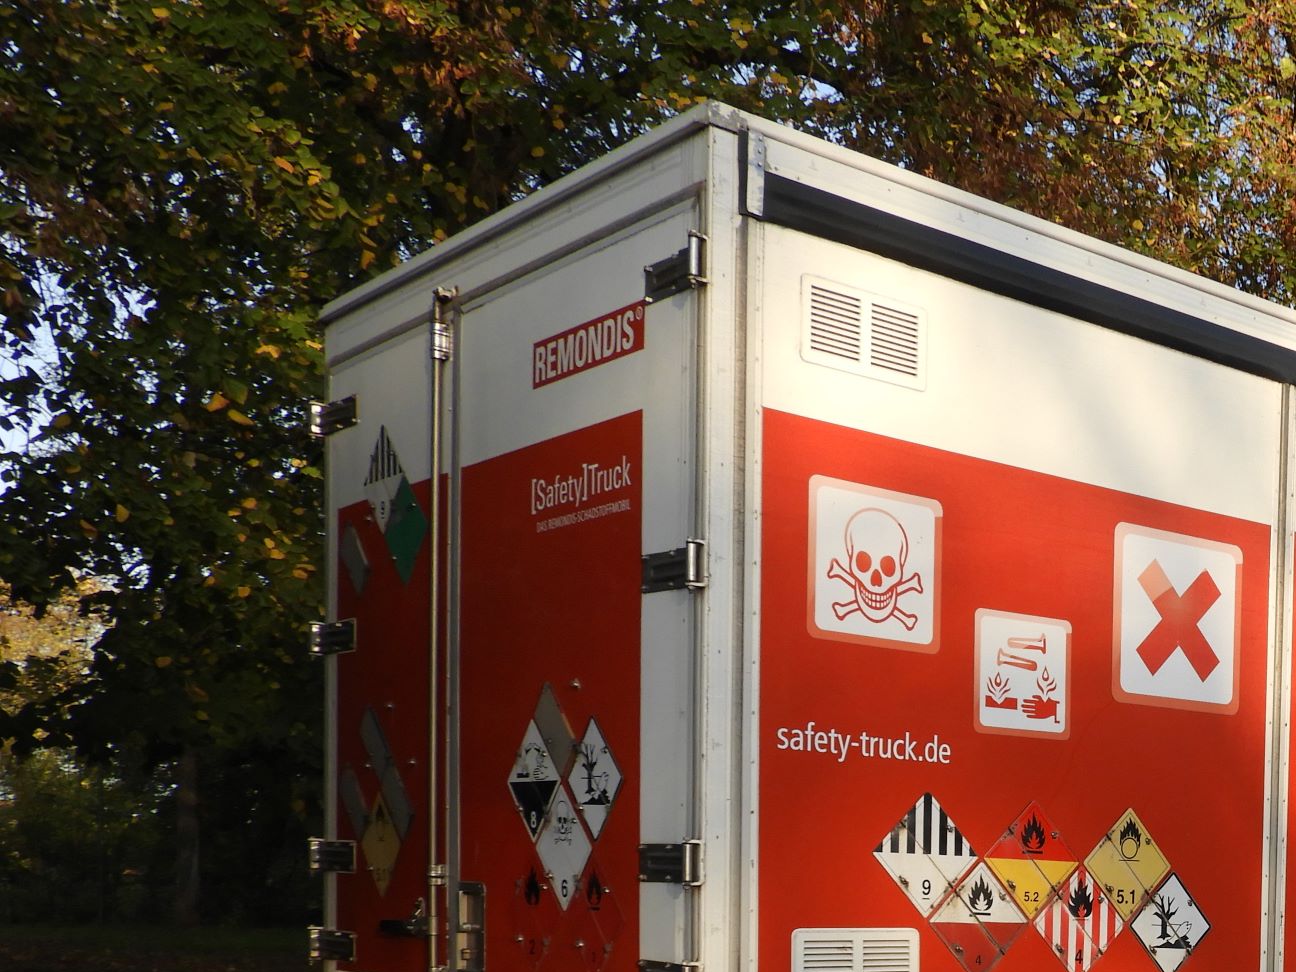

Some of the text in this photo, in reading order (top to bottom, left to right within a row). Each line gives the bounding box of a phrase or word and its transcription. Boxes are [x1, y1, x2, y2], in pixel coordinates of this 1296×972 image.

[776, 721, 951, 764] safety-truck.de
[530, 811, 537, 828] 8
[561, 879, 568, 898] 6
[922, 879, 931, 895] 9
[1023, 891, 1039, 902] 5.2
[1116, 889, 1136, 904] 5.1
[975, 955, 982, 966] 4
[1075, 949, 1083, 964] 4
